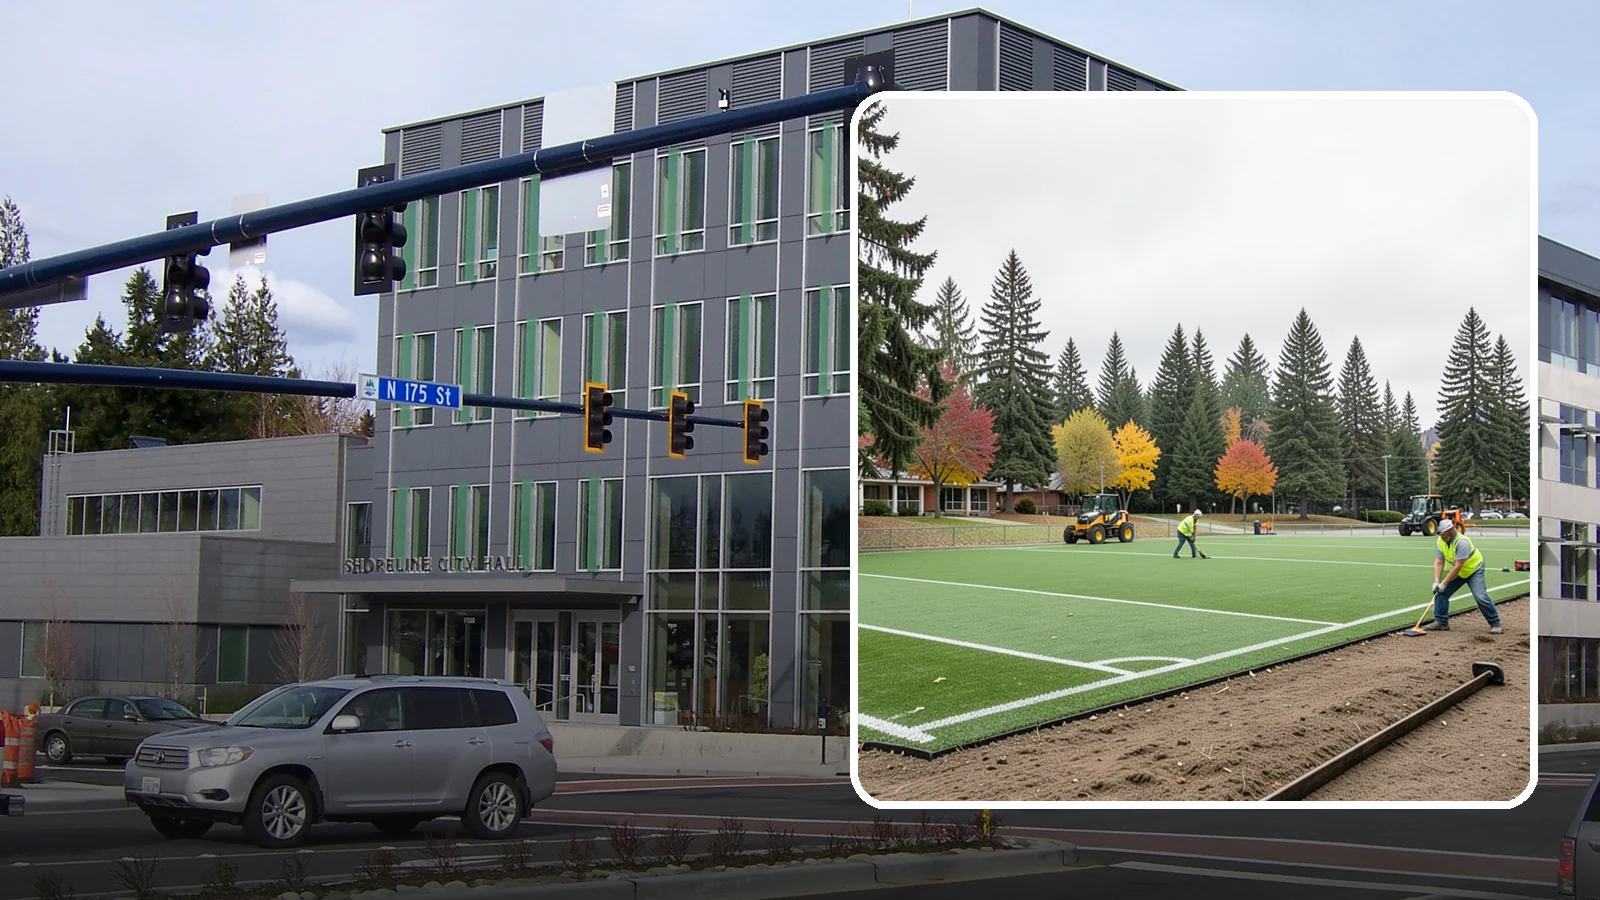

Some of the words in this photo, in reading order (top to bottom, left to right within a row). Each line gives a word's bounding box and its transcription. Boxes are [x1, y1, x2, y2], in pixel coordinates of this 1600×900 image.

[387, 380, 396, 399] N
[405, 382, 427, 403] 175
[436, 386, 451, 405] St
[345, 557, 431, 574] SHORELINE
[438, 557, 475, 572] CITY
[483, 556, 525, 571] HALL
